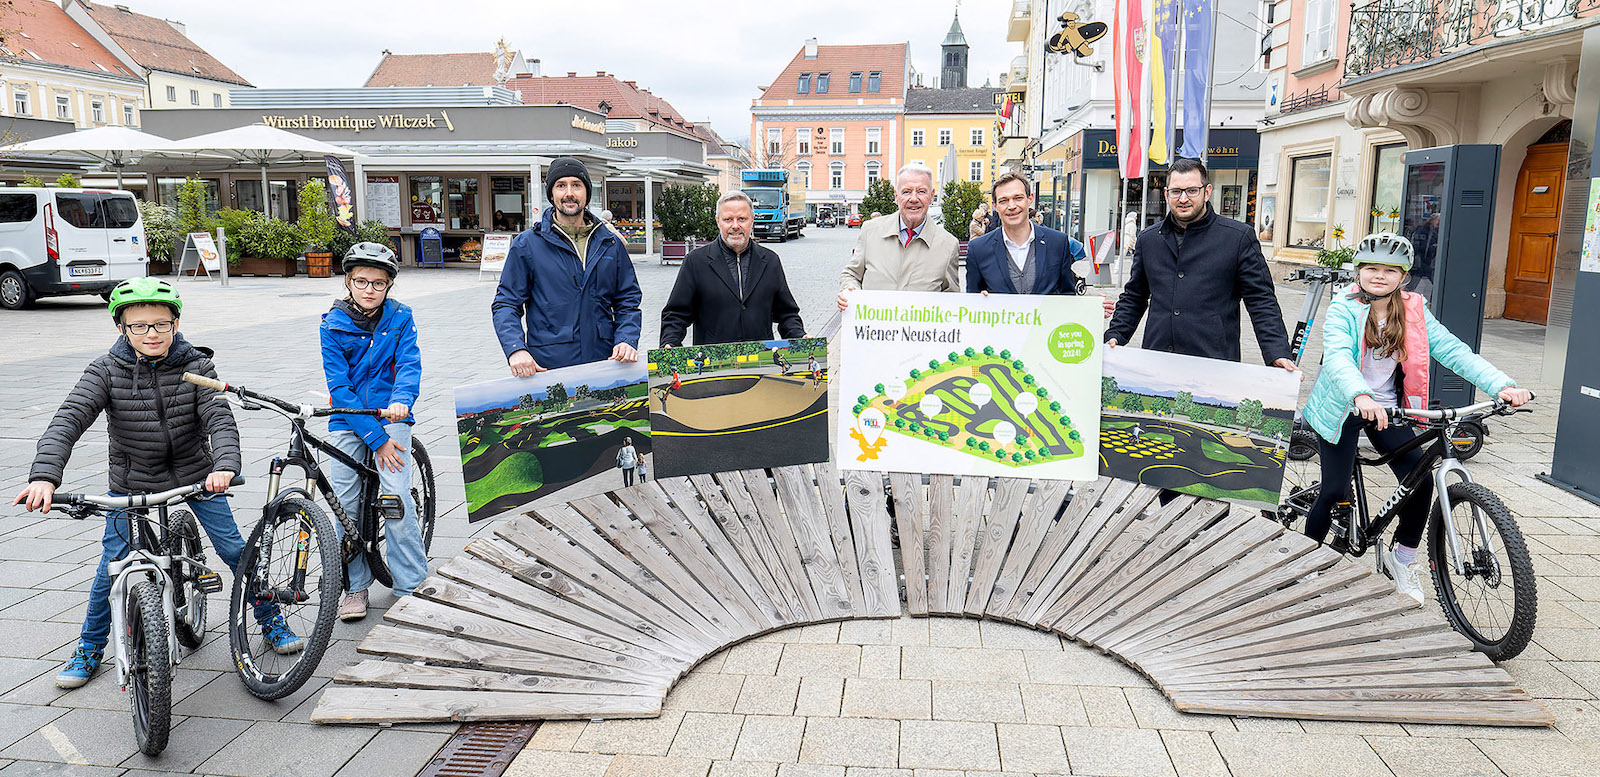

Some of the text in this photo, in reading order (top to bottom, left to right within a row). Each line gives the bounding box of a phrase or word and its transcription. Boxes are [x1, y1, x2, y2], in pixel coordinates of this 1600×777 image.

[262, 114, 436, 133] Würstl Boutique Wilczek
[606, 137, 638, 148] Jakob
[1098, 140, 1118, 154] De
[855, 304, 1042, 327] Mountainbike-Pumptrack
[855, 325, 962, 343] Wiener Neustadt
[1058, 331, 1083, 339] See you
[1291, 328, 1305, 355] BIRD
[1057, 339, 1085, 349] in spring
[1062, 349, 1082, 358] 2024!
[1377, 484, 1410, 518] woom
